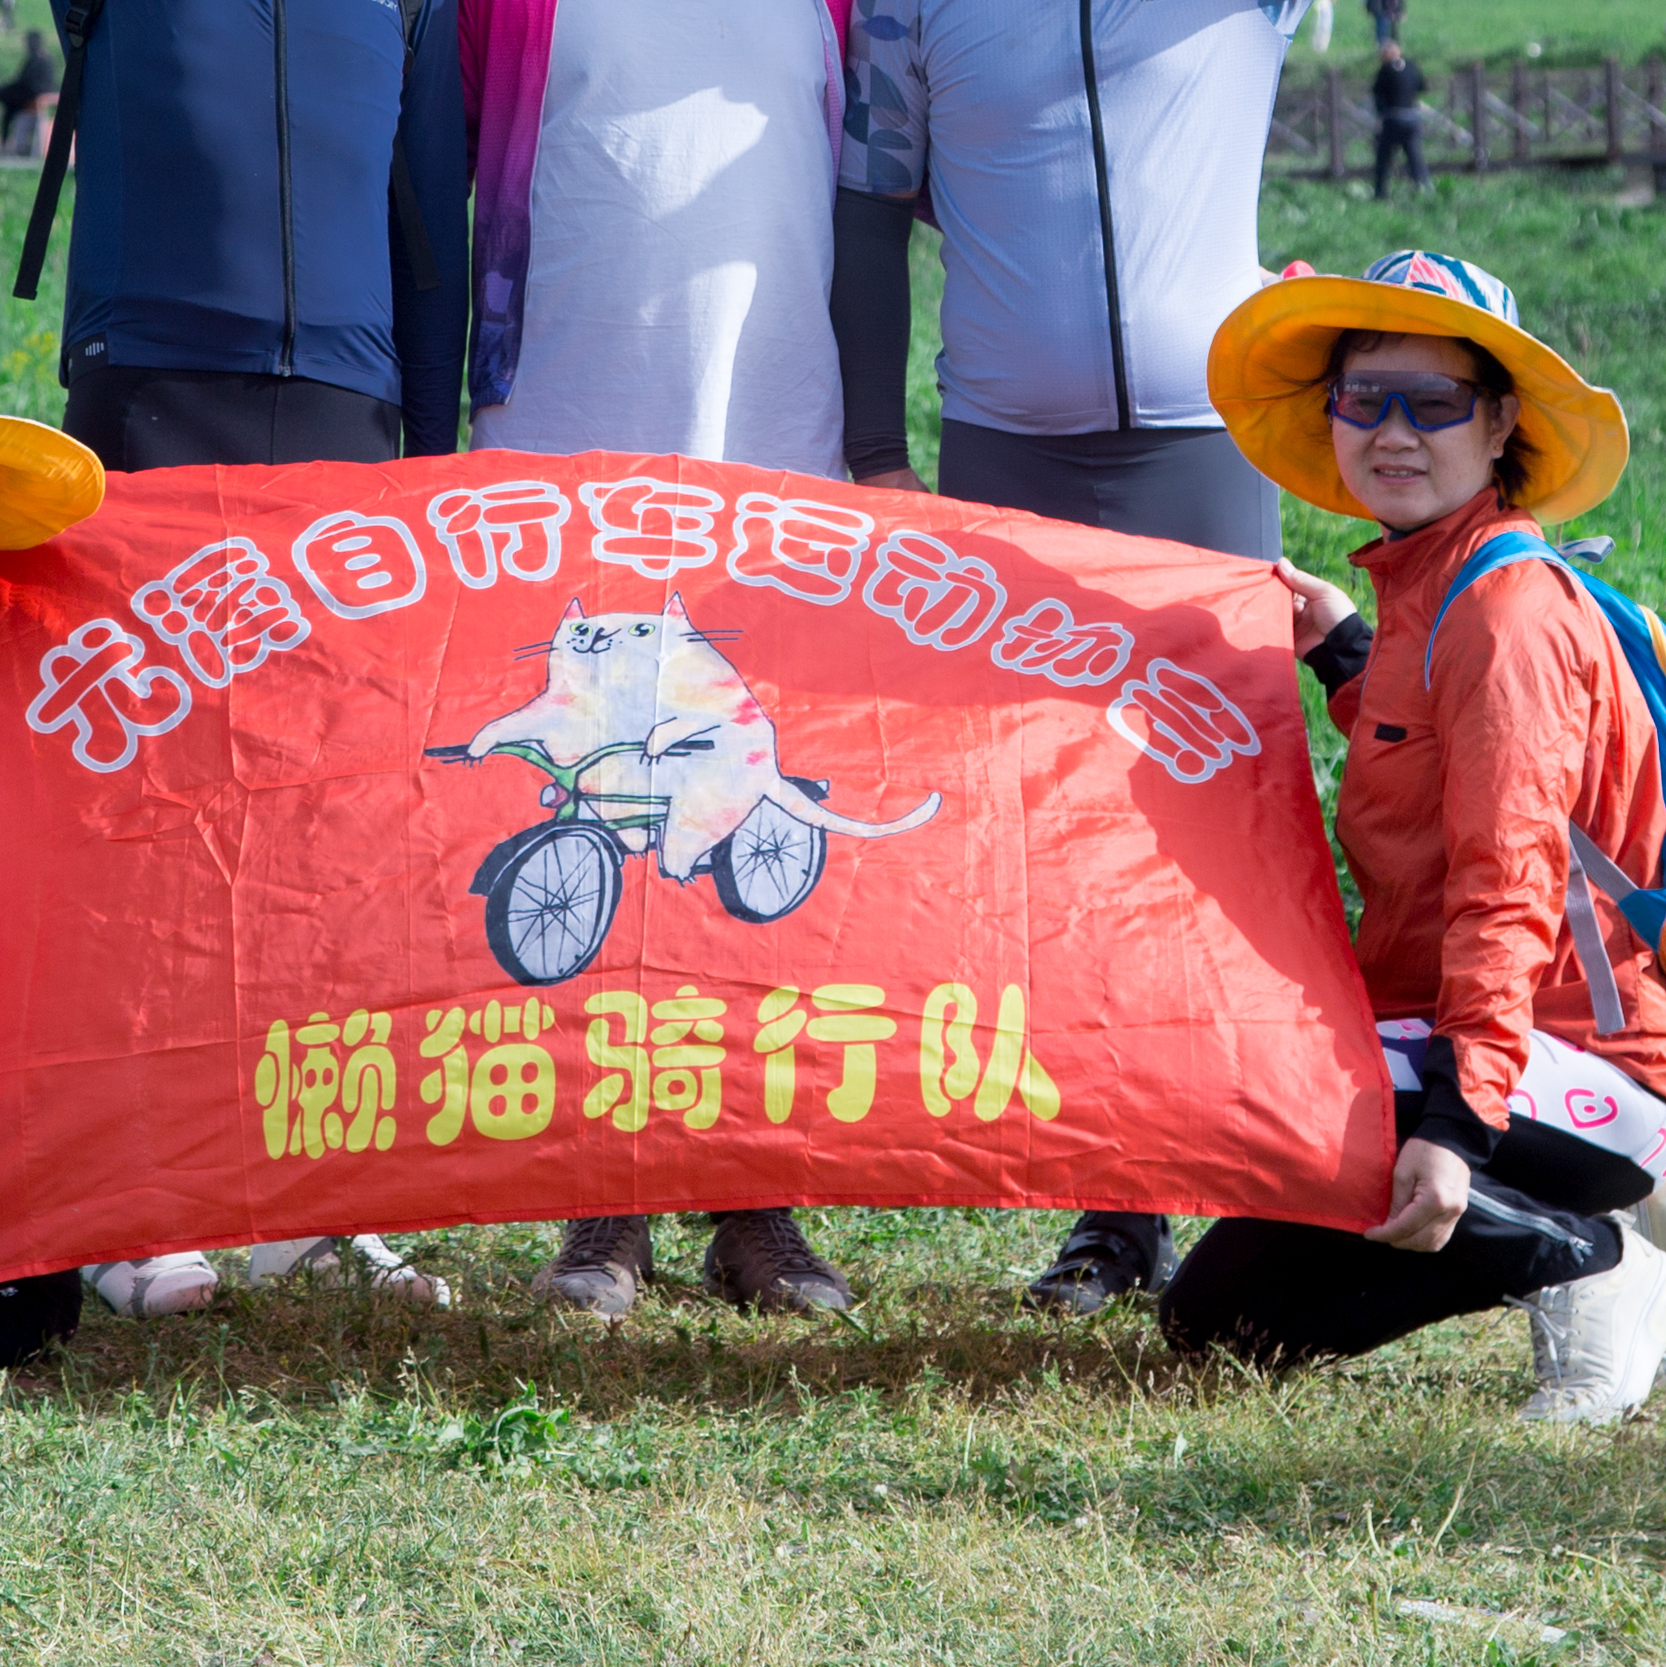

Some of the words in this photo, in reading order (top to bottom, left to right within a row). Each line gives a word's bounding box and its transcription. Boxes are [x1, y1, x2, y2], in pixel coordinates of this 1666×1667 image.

[25, 476, 1263, 784] 尤溪自行车运动协会
[255, 982, 1062, 1161] 懒猫骑行队
